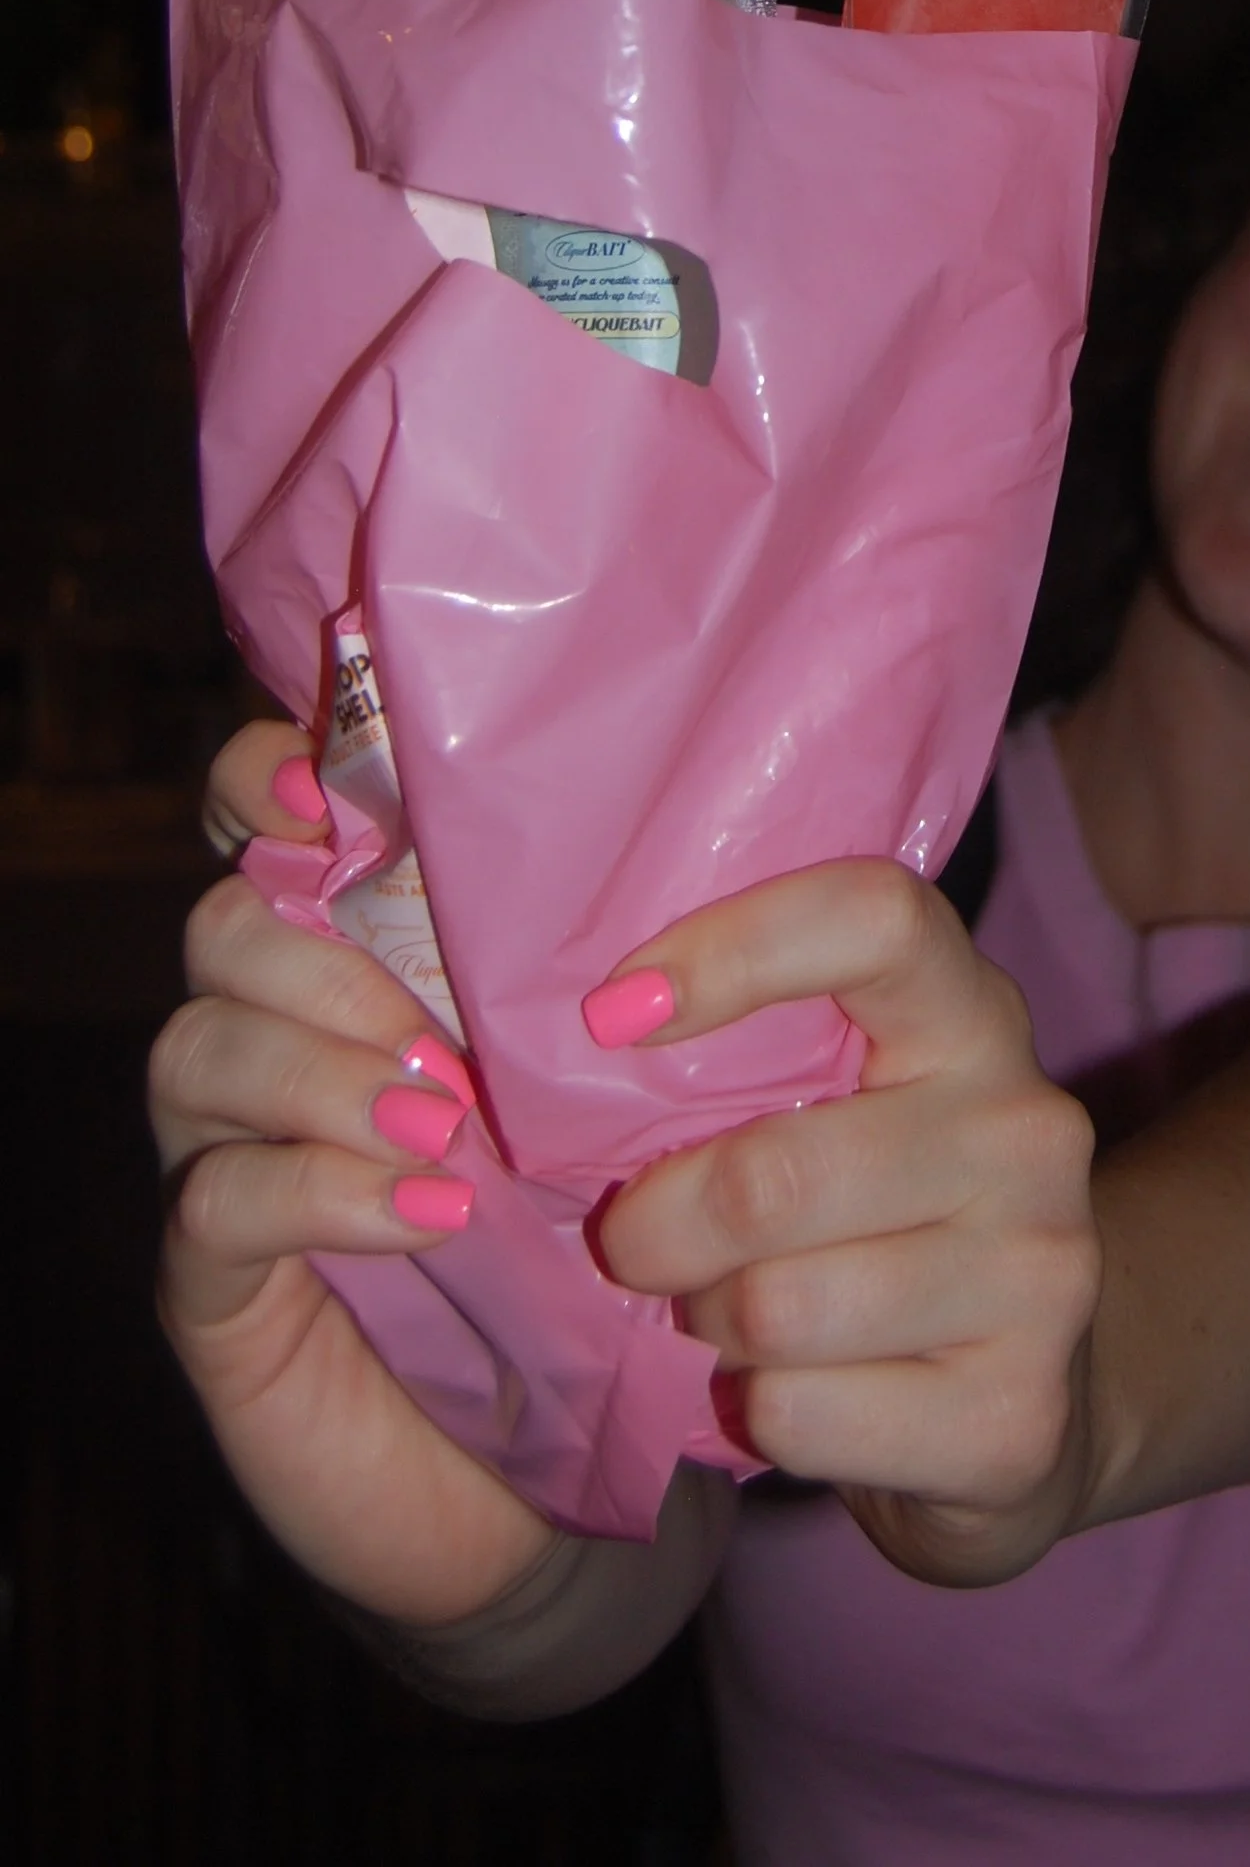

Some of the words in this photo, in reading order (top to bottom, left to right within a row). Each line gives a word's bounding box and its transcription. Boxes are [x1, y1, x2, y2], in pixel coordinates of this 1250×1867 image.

[572, 275, 588, 288] for
[599, 276, 639, 285] creative
[570, 317, 664, 333] CLIQUEBAIT
[336, 654, 371, 694] OP
